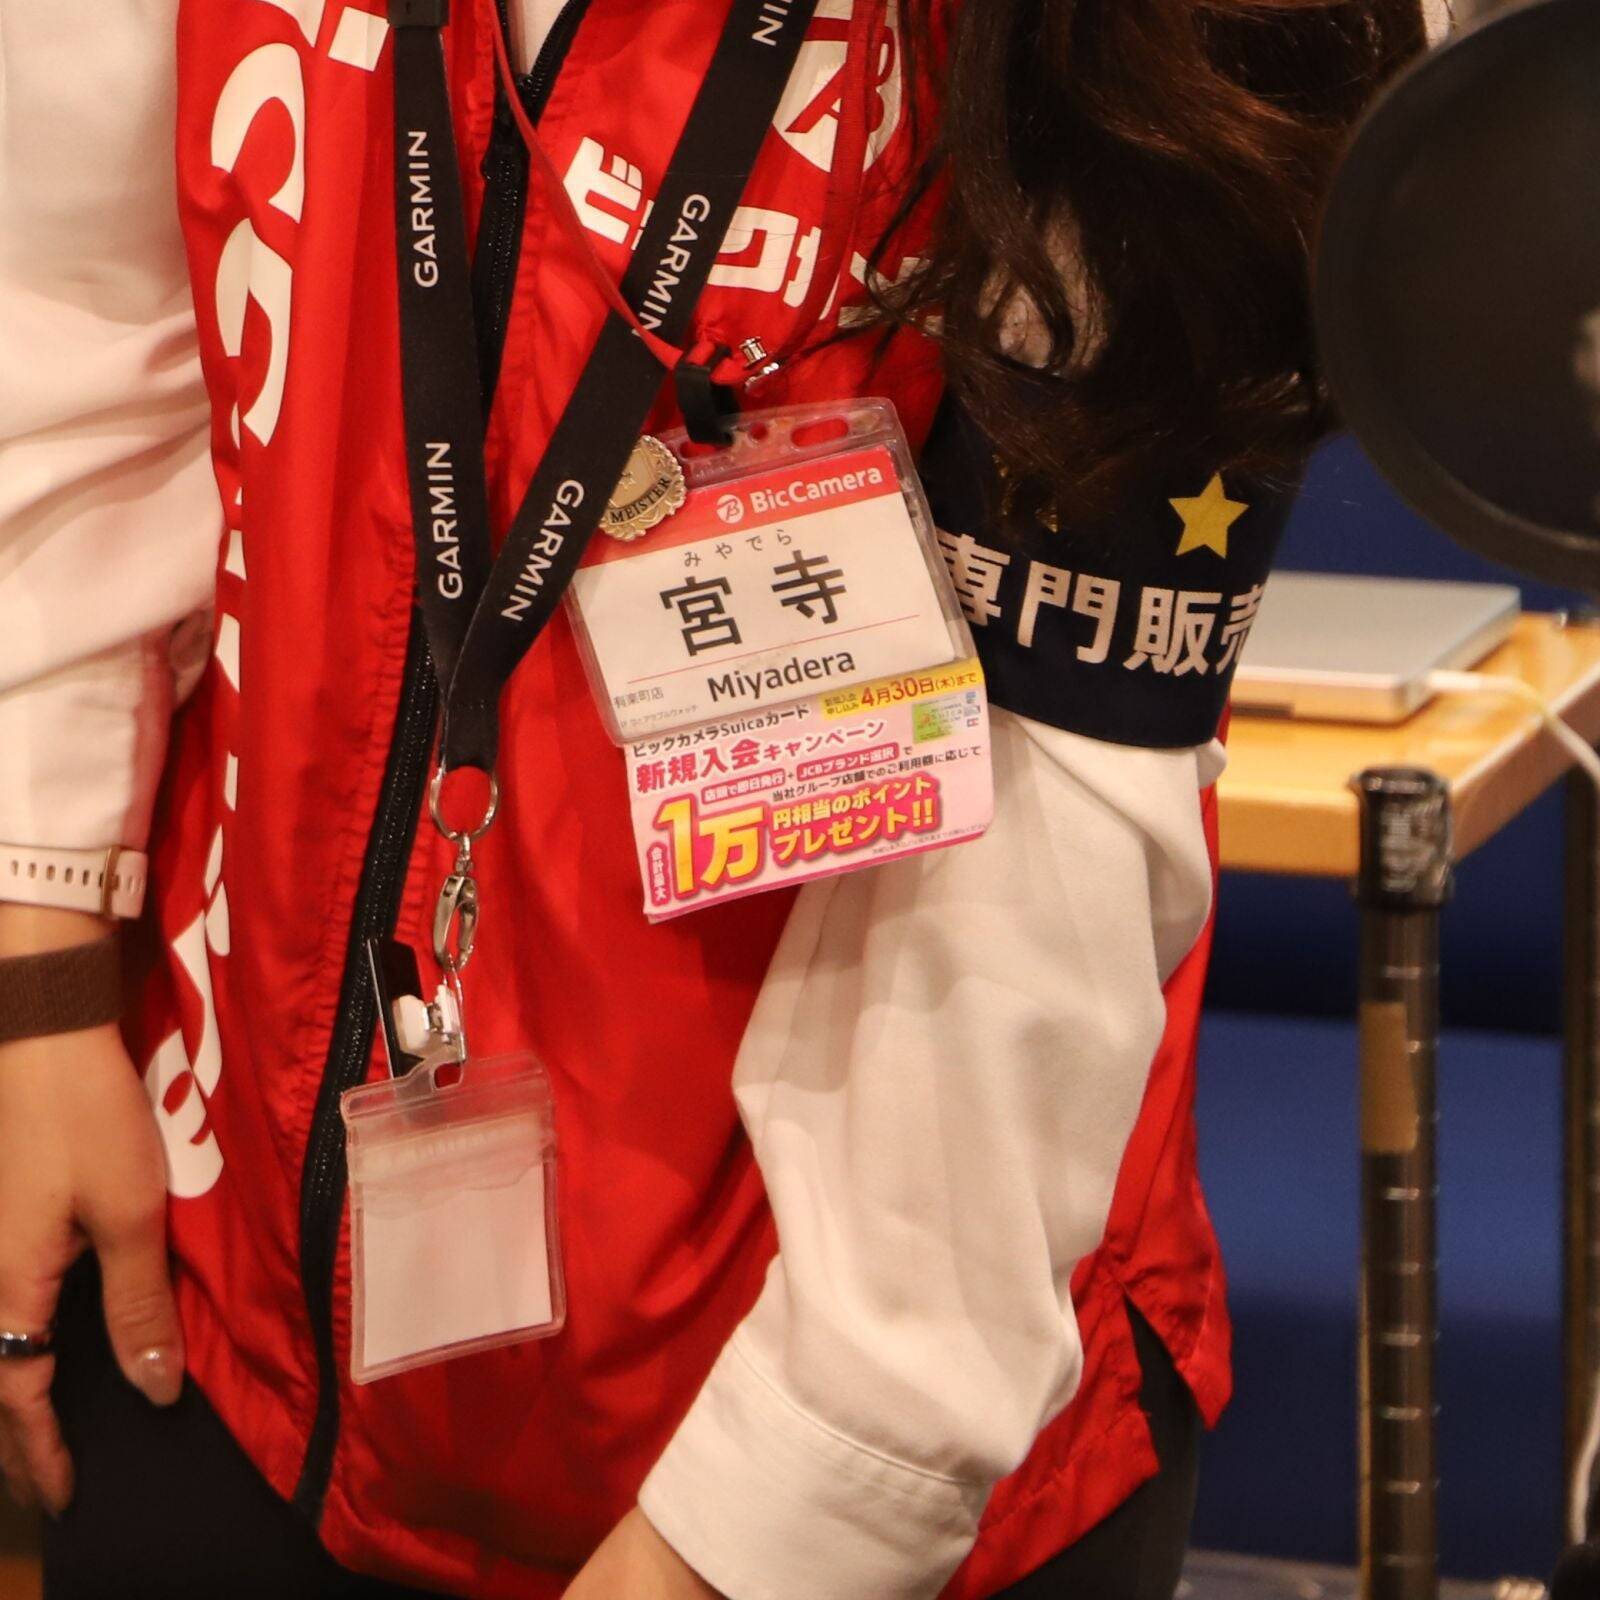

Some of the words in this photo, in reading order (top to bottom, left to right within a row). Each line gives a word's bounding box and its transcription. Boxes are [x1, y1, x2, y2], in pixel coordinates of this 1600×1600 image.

[408, 131, 440, 288] GARMIN
[631, 193, 711, 337] GARMIN
[425, 442, 463, 600] GARMIN
[609, 476, 673, 526] MEISTER
[749, 466, 884, 514] BicCamera
[500, 479, 585, 622] GARMIN
[683, 528, 793, 568] みやでら
[659, 549, 848, 657] 宮寺
[707, 651, 856, 703] Miyadera
[632, 703, 810, 758] ビックカメラSuicaカード
[636, 720, 885, 794] 新規入会キャンペーン
[773, 776, 932, 830] 円相当のポイント
[657, 798, 764, 894] 1万
